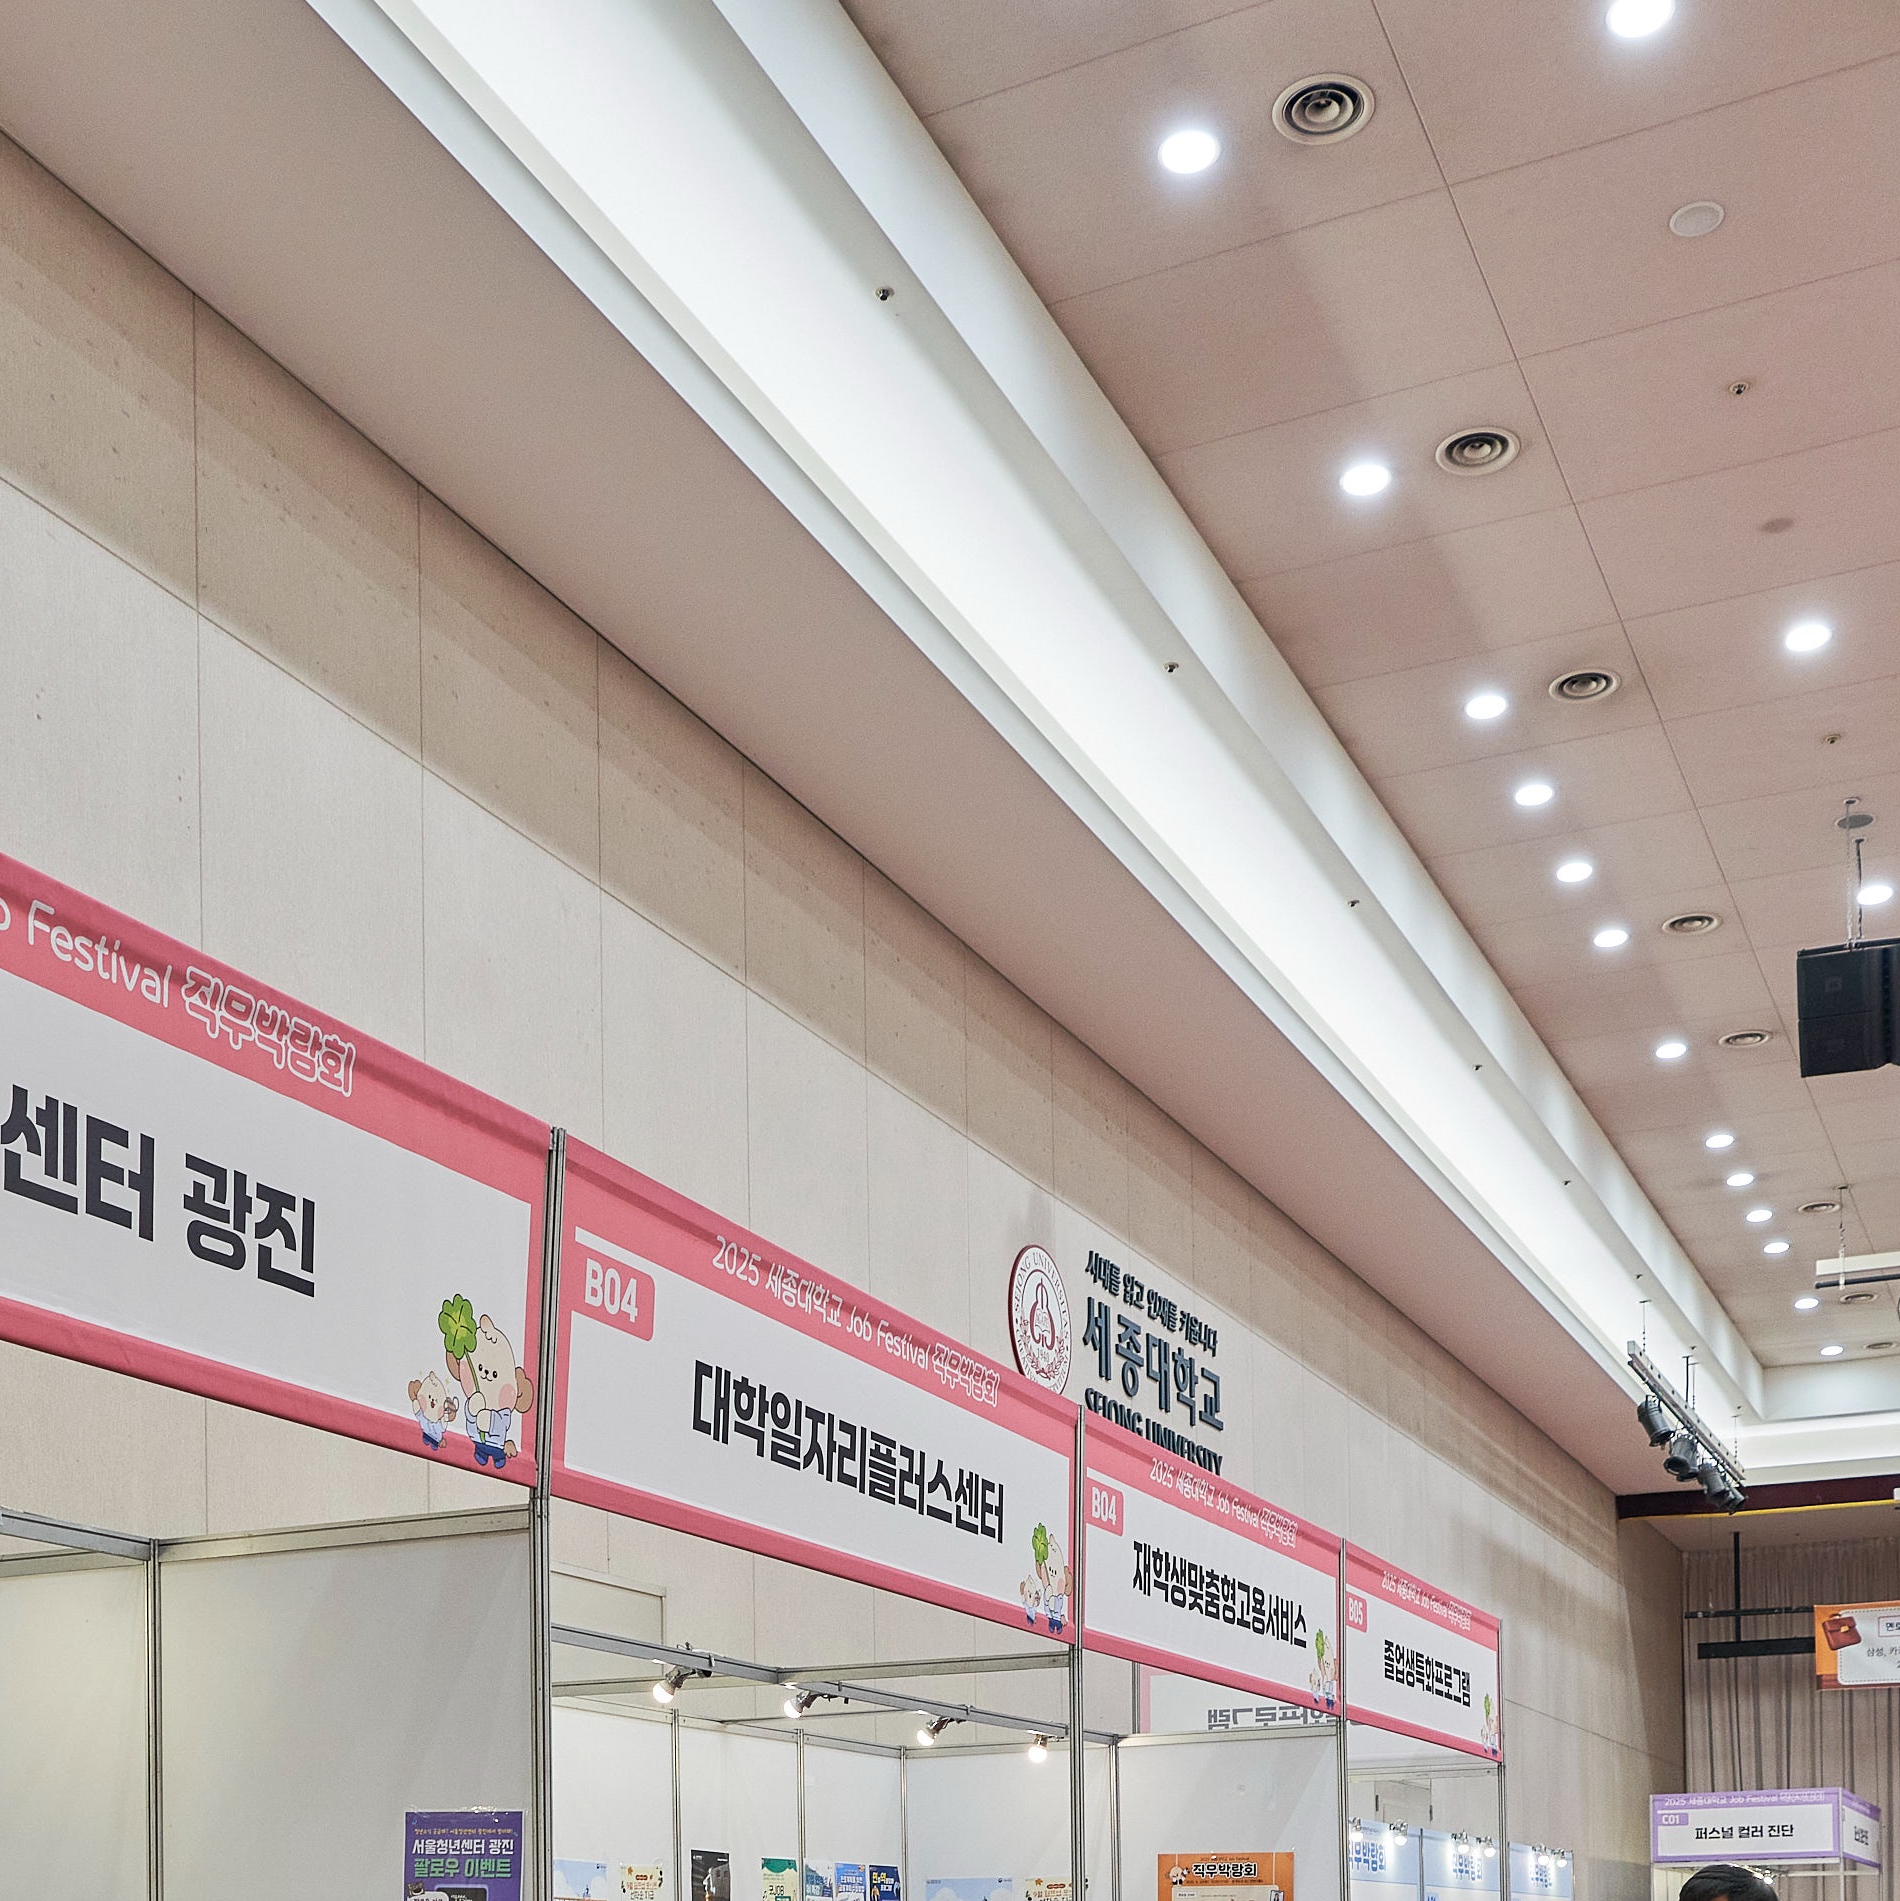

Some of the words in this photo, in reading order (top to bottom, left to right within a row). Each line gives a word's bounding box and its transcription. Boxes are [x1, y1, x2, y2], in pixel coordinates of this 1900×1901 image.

[28, 898, 169, 1008] Festival
[181, 965, 355, 1098] 직무박람회
[183, 1153, 316, 1298] 광진
[584, 1257, 638, 1324] B04
[711, 1234, 761, 1287] 2025
[765, 1261, 843, 1328] 세종대학교
[846, 1307, 873, 1343] Job
[877, 1321, 930, 1371] Festival
[932, 1342, 1000, 1408] 직무박람회
[1085, 1250, 1121, 1297] 시대를
[1147, 1289, 1178, 1332] 인재를
[1179, 1310, 1218, 1357] 키웁니다
[1083, 1297, 1223, 1430] 세종대학교
[692, 1359, 1005, 1544] 대학일자리플러스센터
[1091, 1487, 1117, 1525] B04
[1150, 1457, 1172, 1488] 2025
[1176, 1470, 1215, 1512] 세종대학교
[1216, 1493, 1229, 1513] Job
[1232, 1498, 1259, 1527] Festival
[1133, 1541, 1307, 1648] 재학생맞춤형고용서비스
[1349, 1598, 1363, 1625] B05
[1384, 1639, 1471, 1707] 졸업생특화프로그램
[1866, 1648, 1886, 1657] 삼성,
[1662, 1815, 1680, 1825] C01
[1665, 1798, 1686, 1806] 2025
[1729, 1796, 1744, 1804] Job
[1746, 1794, 1779, 1803] Festival
[1695, 1827, 1733, 1840] 퍼스널
[1738, 1826, 1764, 1838] 컬러
[1768, 1824, 1794, 1837] 진단
[412, 1839, 485, 1855] 서울청년센터
[489, 1839, 514, 1855] 광진
[414, 1858, 460, 1878] 팔로우
[464, 1858, 512, 1878] 이벤트
[1192, 1863, 1257, 1878] 직무박람회
